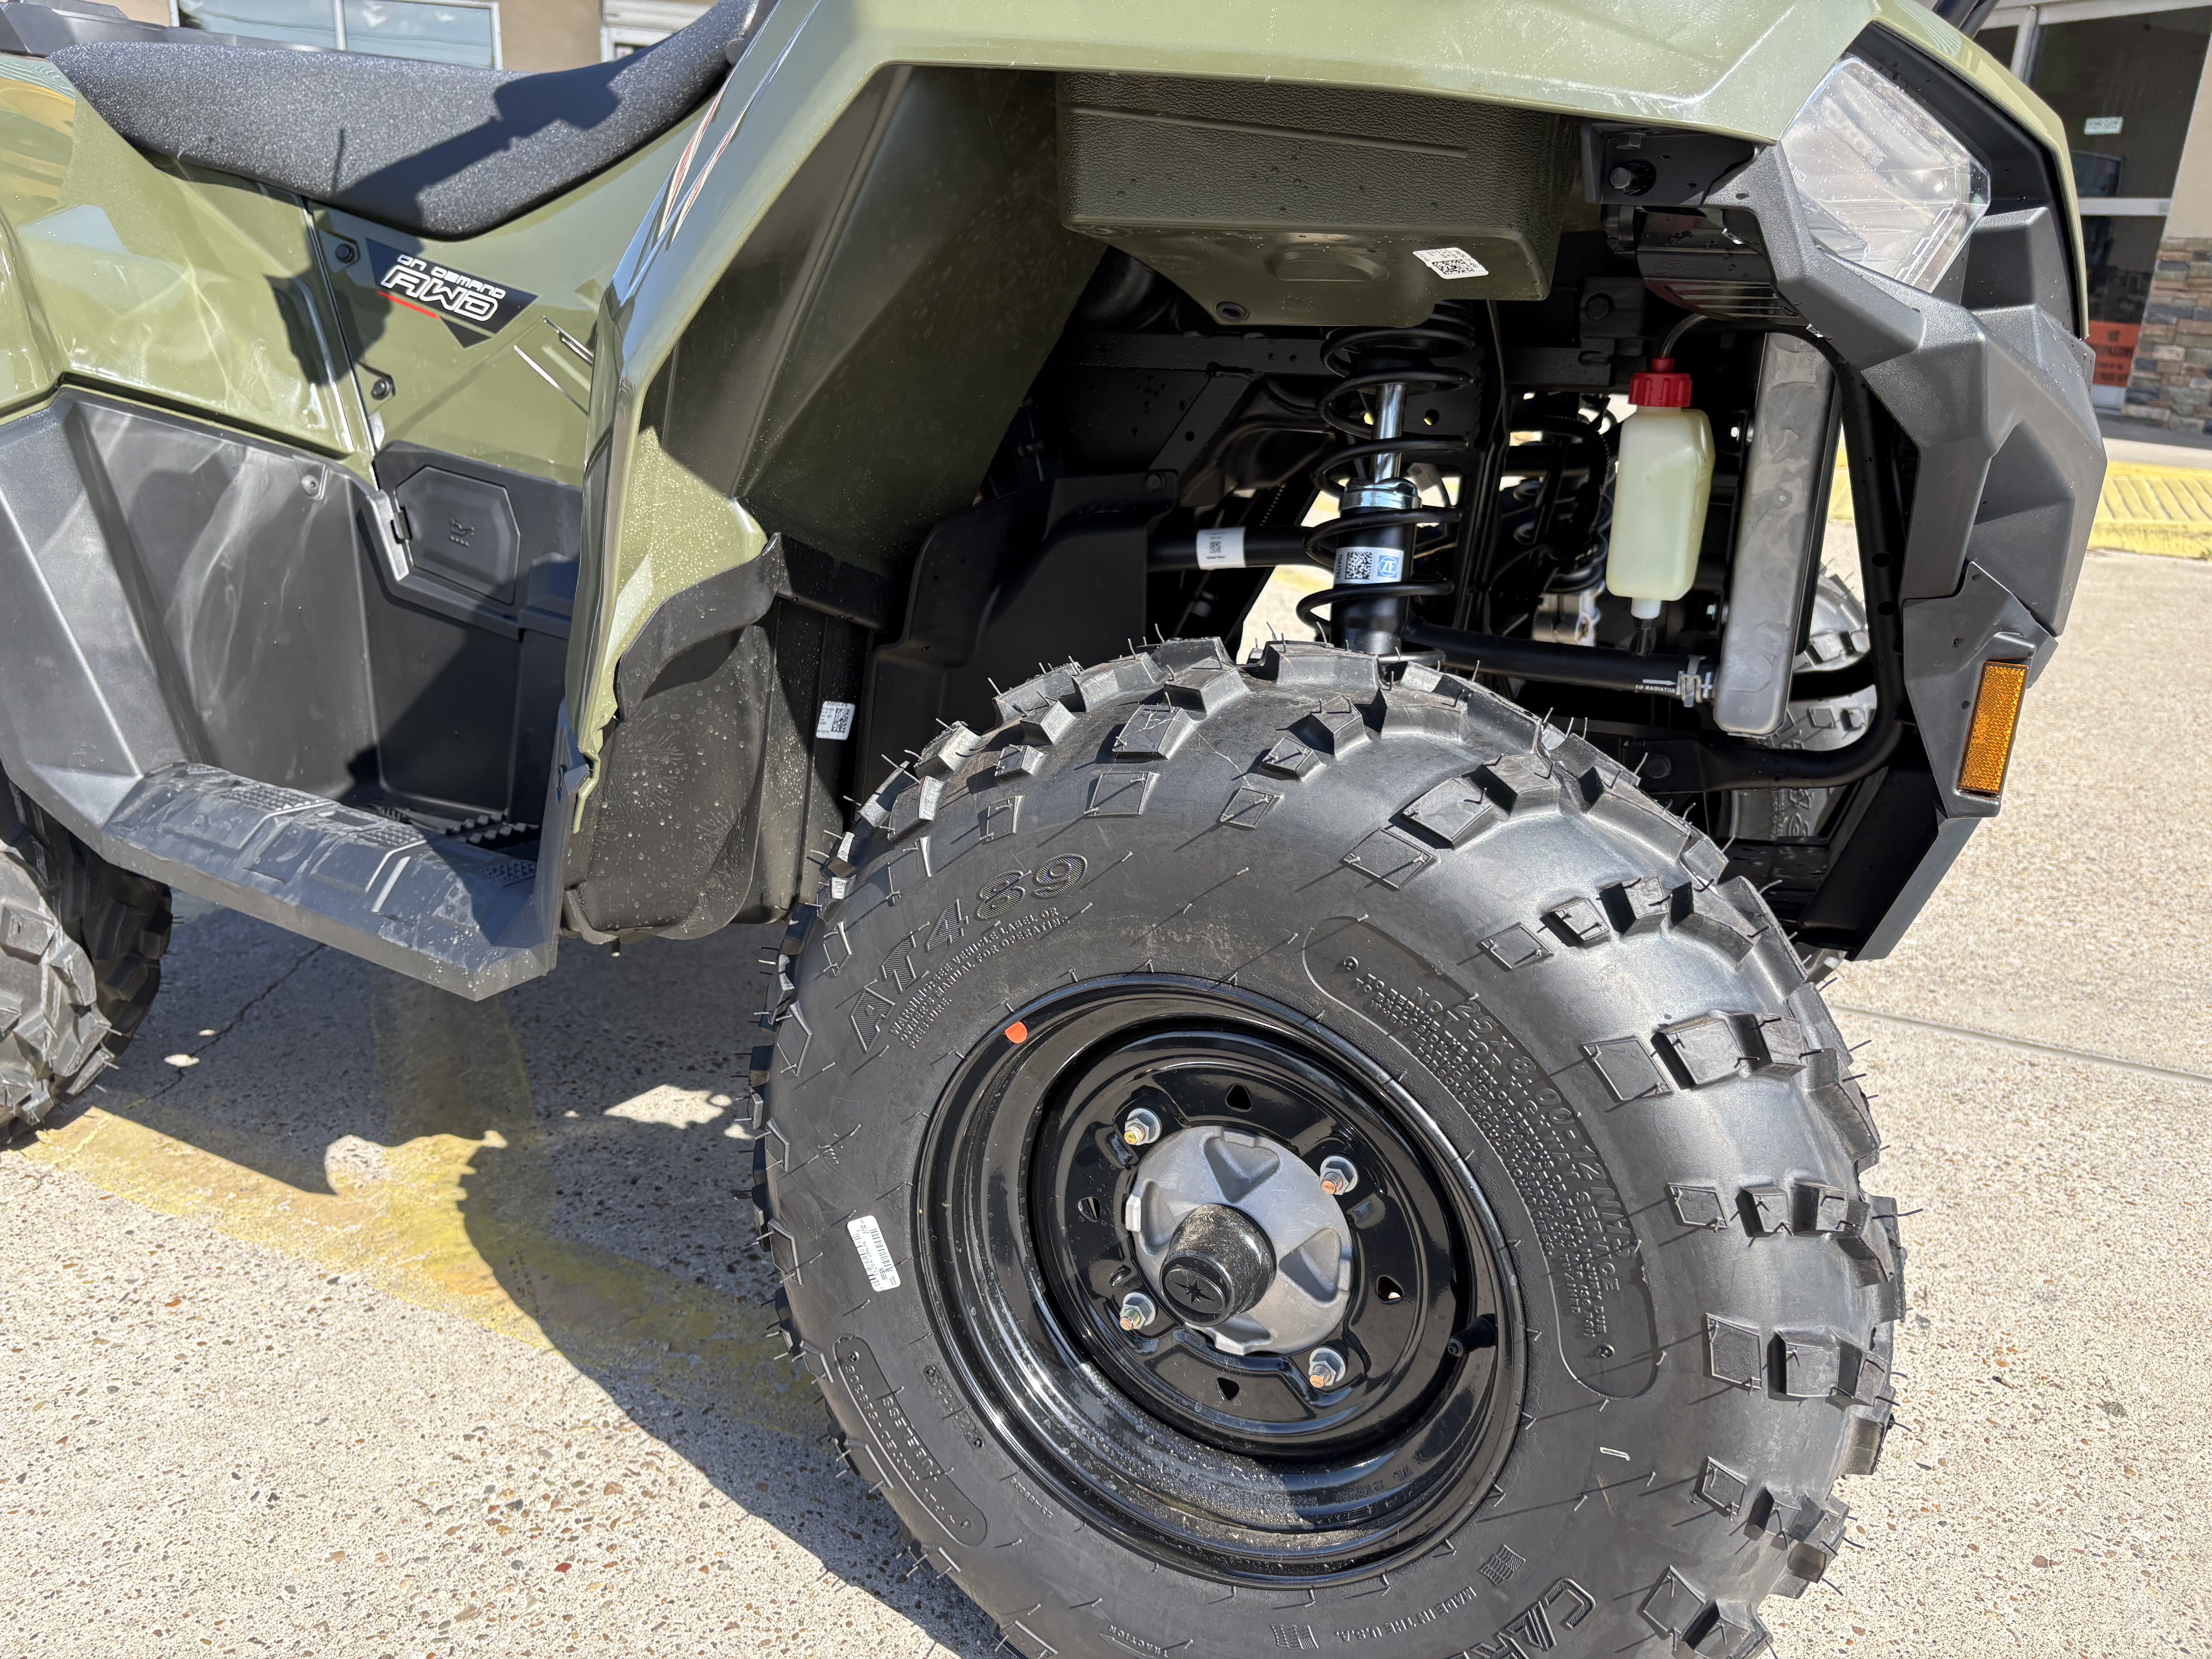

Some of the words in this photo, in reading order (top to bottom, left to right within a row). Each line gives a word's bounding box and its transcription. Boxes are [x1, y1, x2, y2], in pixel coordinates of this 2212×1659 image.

[380, 264, 498, 321] AWD
[1645, 685, 1676, 694] RADIATOR
[851, 853, 1088, 1052] AT489
[951, 931, 998, 964] VEHICLE
[1000, 915, 1038, 936] LABEL
[1041, 907, 1059, 918] OR
[934, 961, 974, 997] MANUAL
[974, 945, 999, 963] FOR
[1353, 977, 1372, 994] TO
[1451, 1055, 1469, 1072] DO
[1470, 1075, 1496, 1102] NOT
[1494, 1104, 1536, 1159] INFLATE
[1532, 1162, 1566, 1216] BEYOND
[1365, 972, 1385, 990] TO
[1388, 988, 1441, 1032] REDUCE
[1441, 1030, 1468, 1057] THE
[1467, 1056, 1498, 1088] RISK
[1496, 1090, 1515, 1108] OF
[1511, 1110, 1555, 1170] SERIOUS
[1550, 1173, 1567, 1193] OR
[1563, 1198, 1587, 1243] FATAL
[1410, 986, 1460, 1029] NOT
[1460, 1029, 1503, 1072] FOR
[1501, 1075, 1580, 1179] HIGHWAY
[1574, 1191, 1620, 1291] SERVICE
[1467, 1103, 1509, 1153] SHOULD
[1501, 1131, 1529, 1167] ONLY
[1525, 1170, 1565, 1247] SPECIALLY
[879, 1394, 941, 1482] TUBELESS
[1382, 1617, 1416, 1634] THE
[1415, 1608, 1435, 1625] IN
[1434, 1586, 1477, 1615] MADE
[1107, 1623, 1167, 1657] TRACTION
